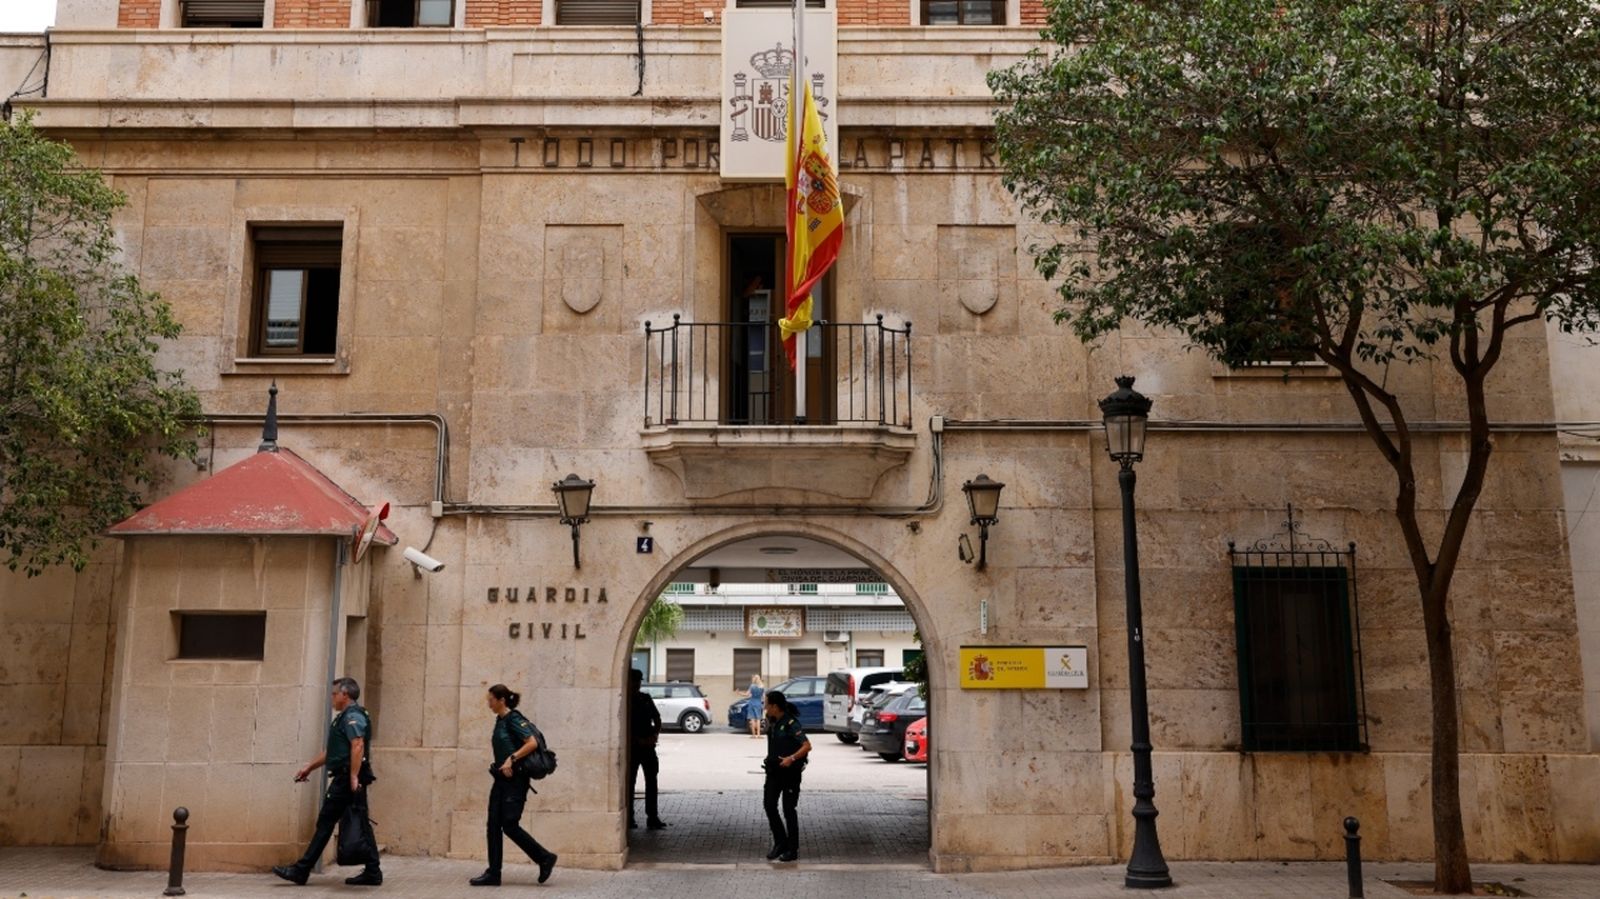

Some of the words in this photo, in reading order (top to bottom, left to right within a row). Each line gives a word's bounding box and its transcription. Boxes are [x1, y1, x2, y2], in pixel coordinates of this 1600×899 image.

[509, 137, 625, 168] TODO
[661, 137, 720, 168] POR
[839, 138, 868, 168] LA
[889, 137, 997, 168] PATR
[640, 538, 649, 552] 4
[487, 587, 608, 603] GUARDIA
[509, 622, 587, 639] CIVIL
